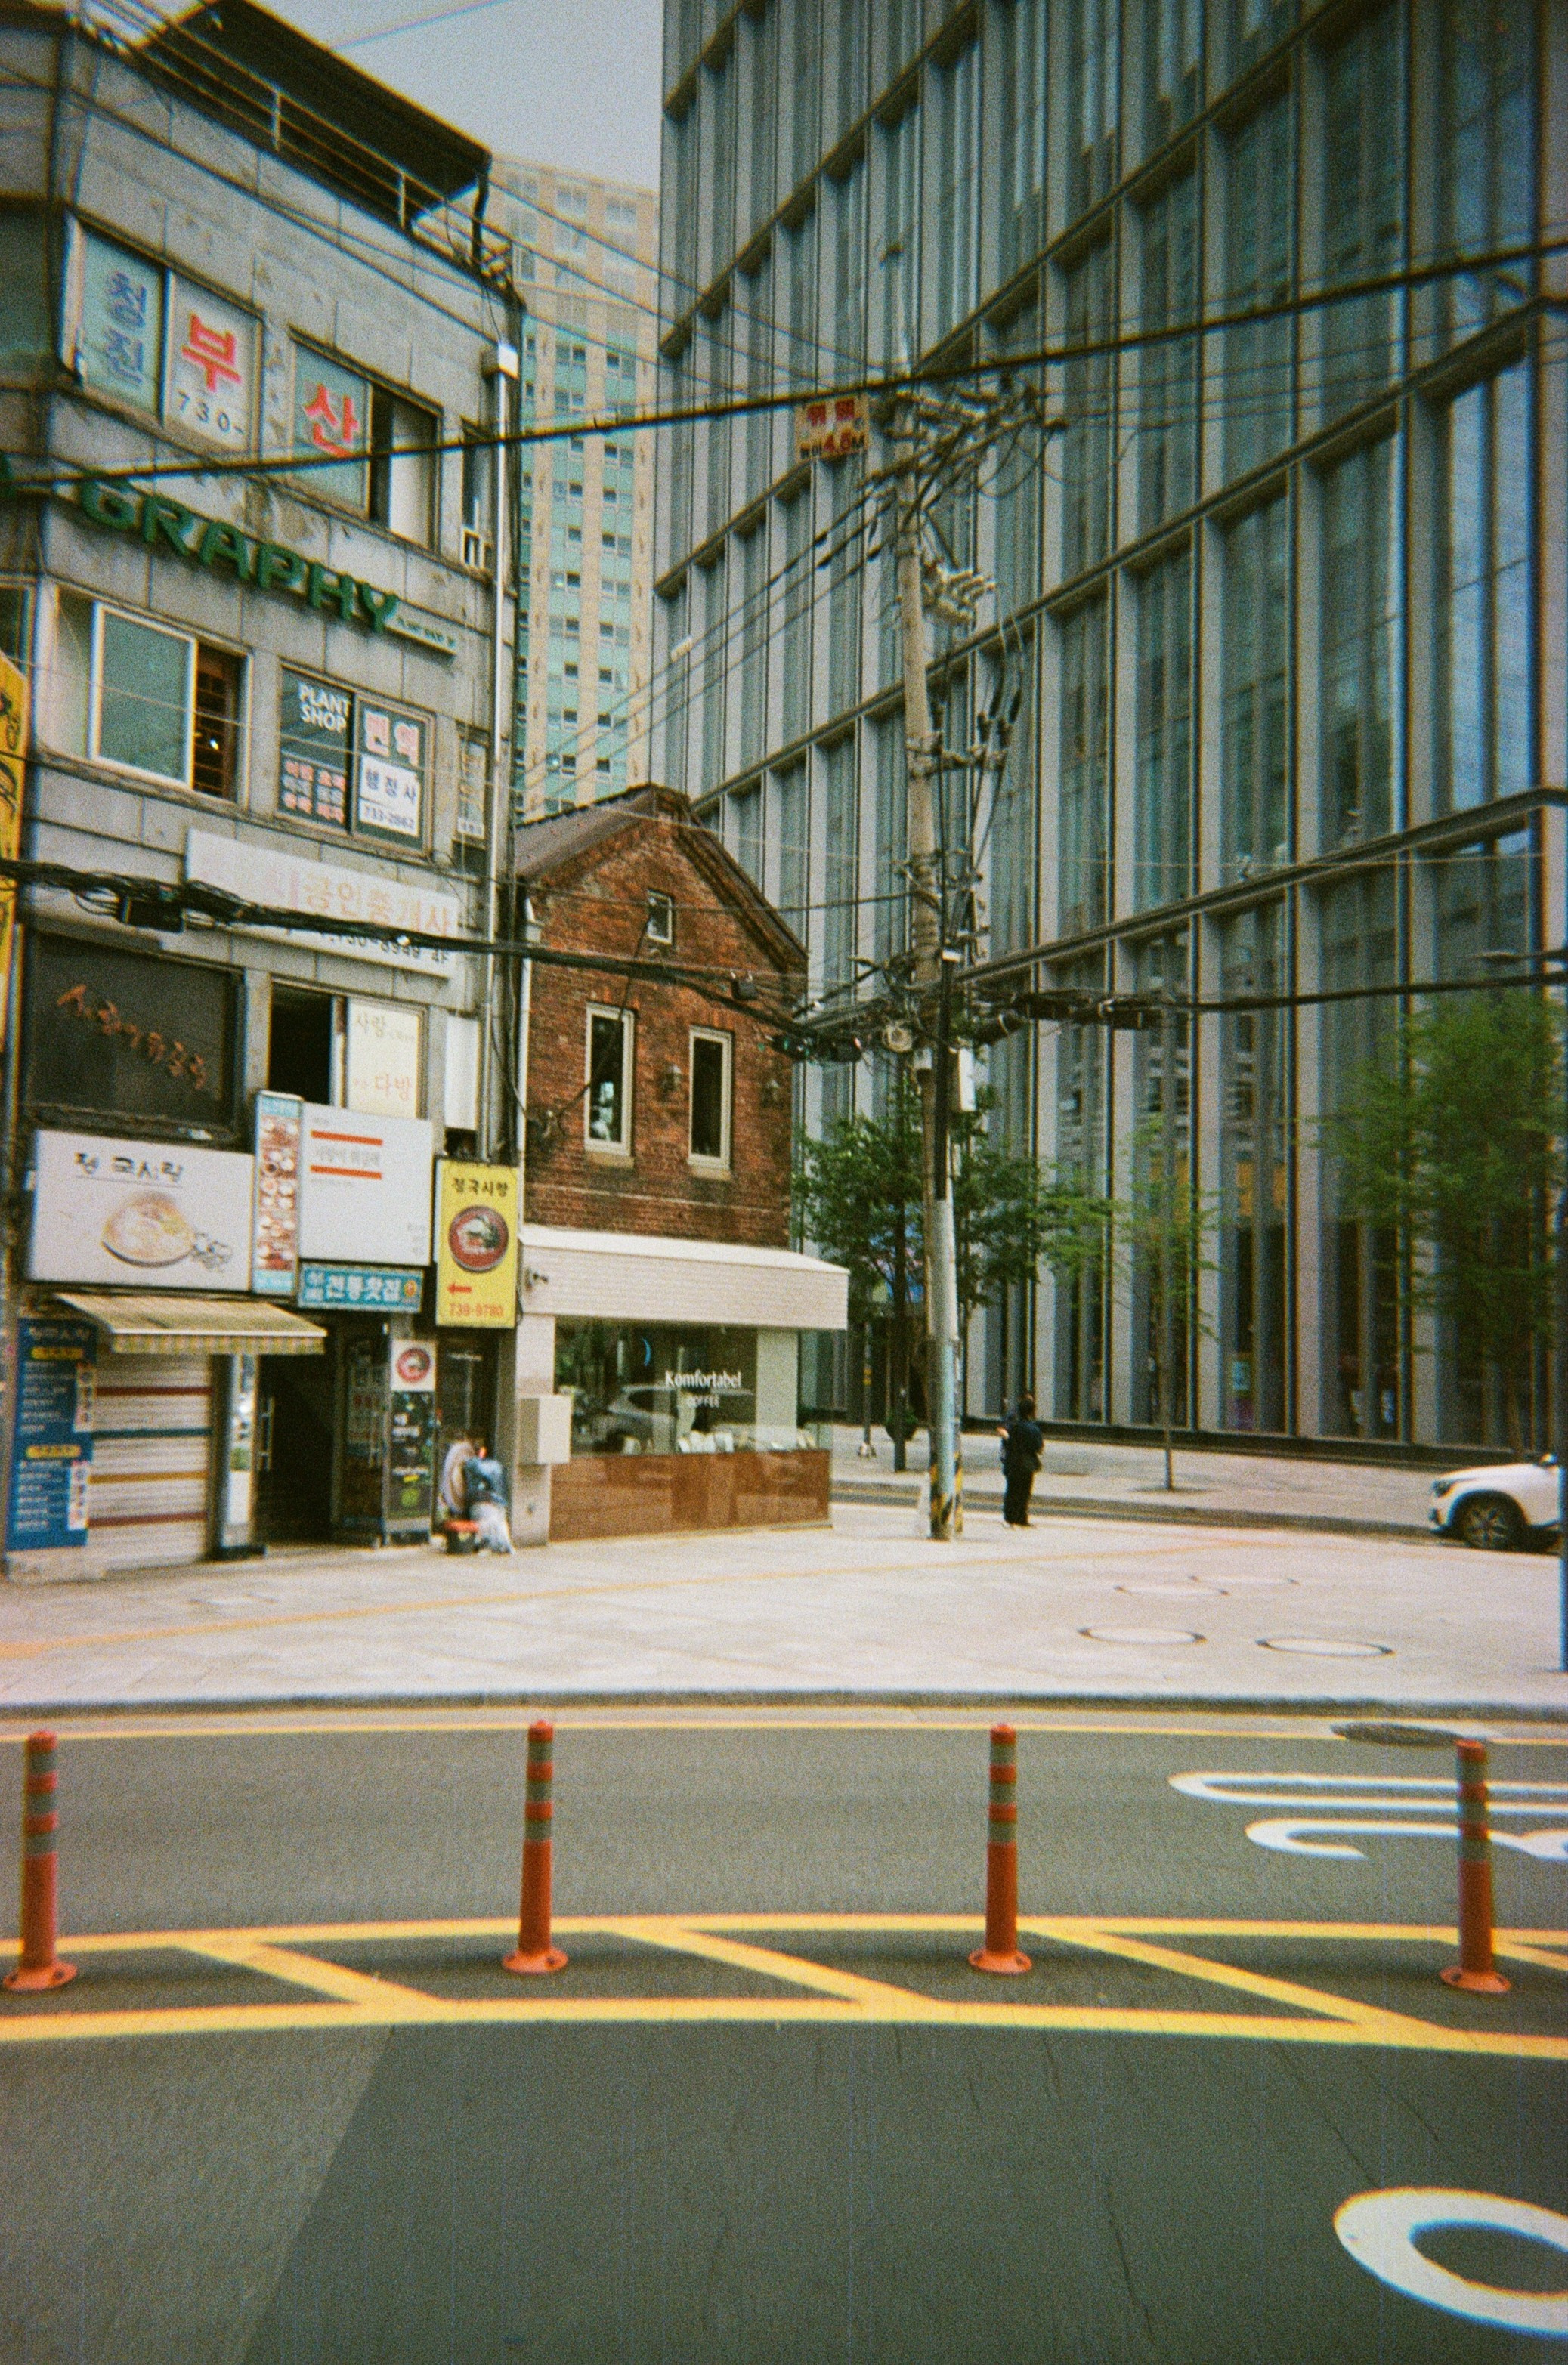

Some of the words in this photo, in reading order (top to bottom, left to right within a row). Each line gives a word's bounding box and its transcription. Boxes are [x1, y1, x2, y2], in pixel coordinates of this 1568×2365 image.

[77, 472, 401, 635] GRAPHY
[298, 681, 351, 717] PLANT
[301, 703, 348, 733] SHOP
[664, 1370, 742, 1389] Komfortabel
